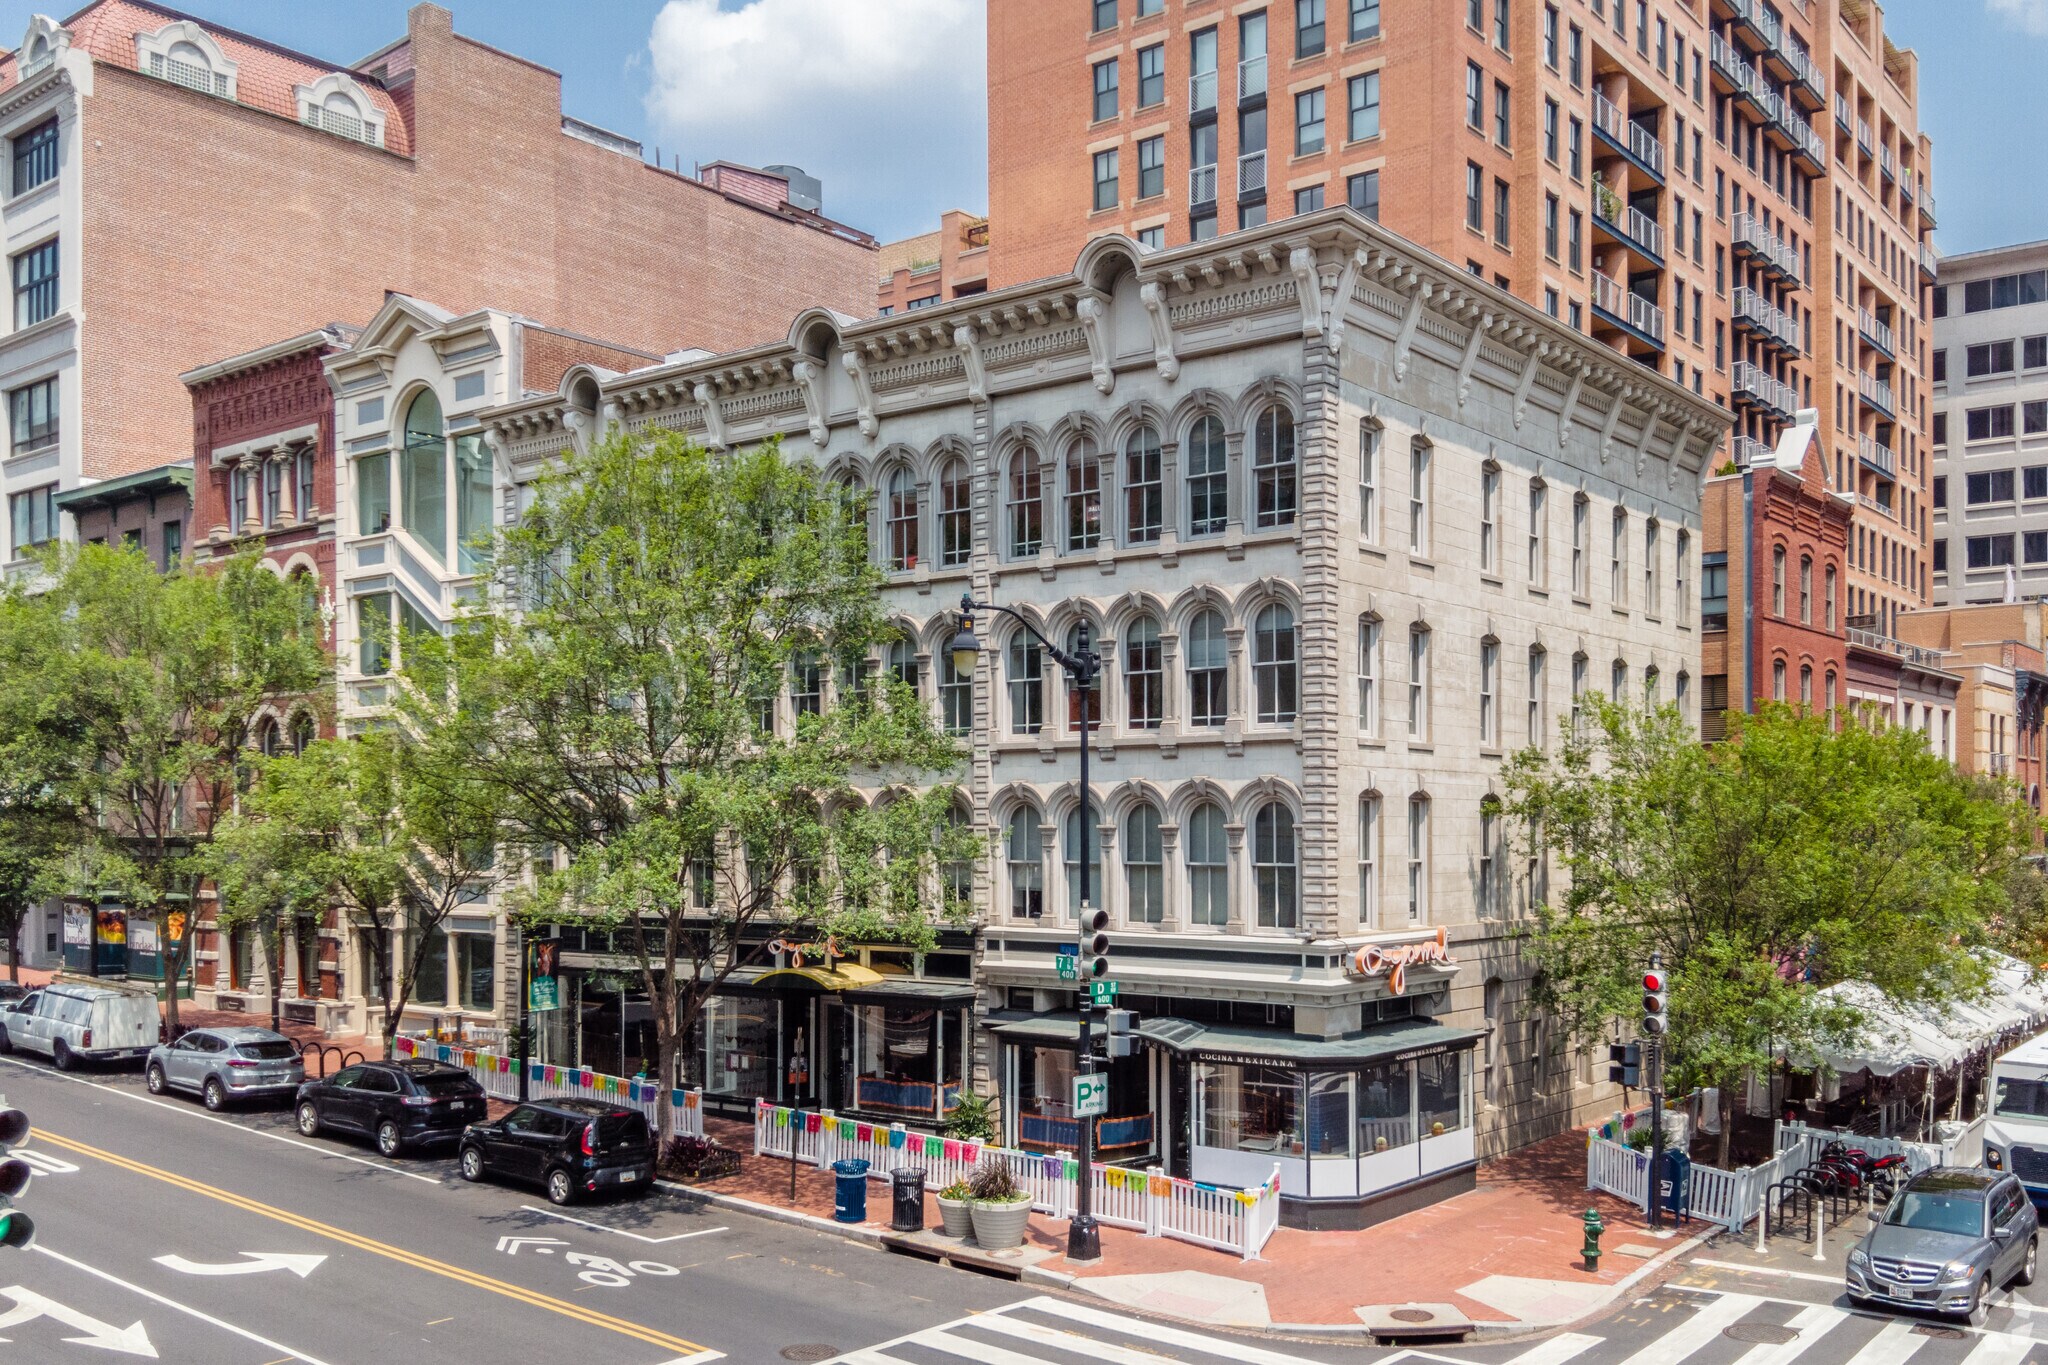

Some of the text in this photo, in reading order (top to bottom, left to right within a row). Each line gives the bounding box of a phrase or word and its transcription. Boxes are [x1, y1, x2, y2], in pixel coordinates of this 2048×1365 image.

[1058, 957, 1064, 968] 7
[1355, 925, 1457, 996] Oyamel
[1062, 970, 1074, 979] 400
[1097, 983, 1105, 995] D
[1097, 995, 1110, 1004] 600
[1199, 1052, 1295, 1068] COCINA MEXICANA
